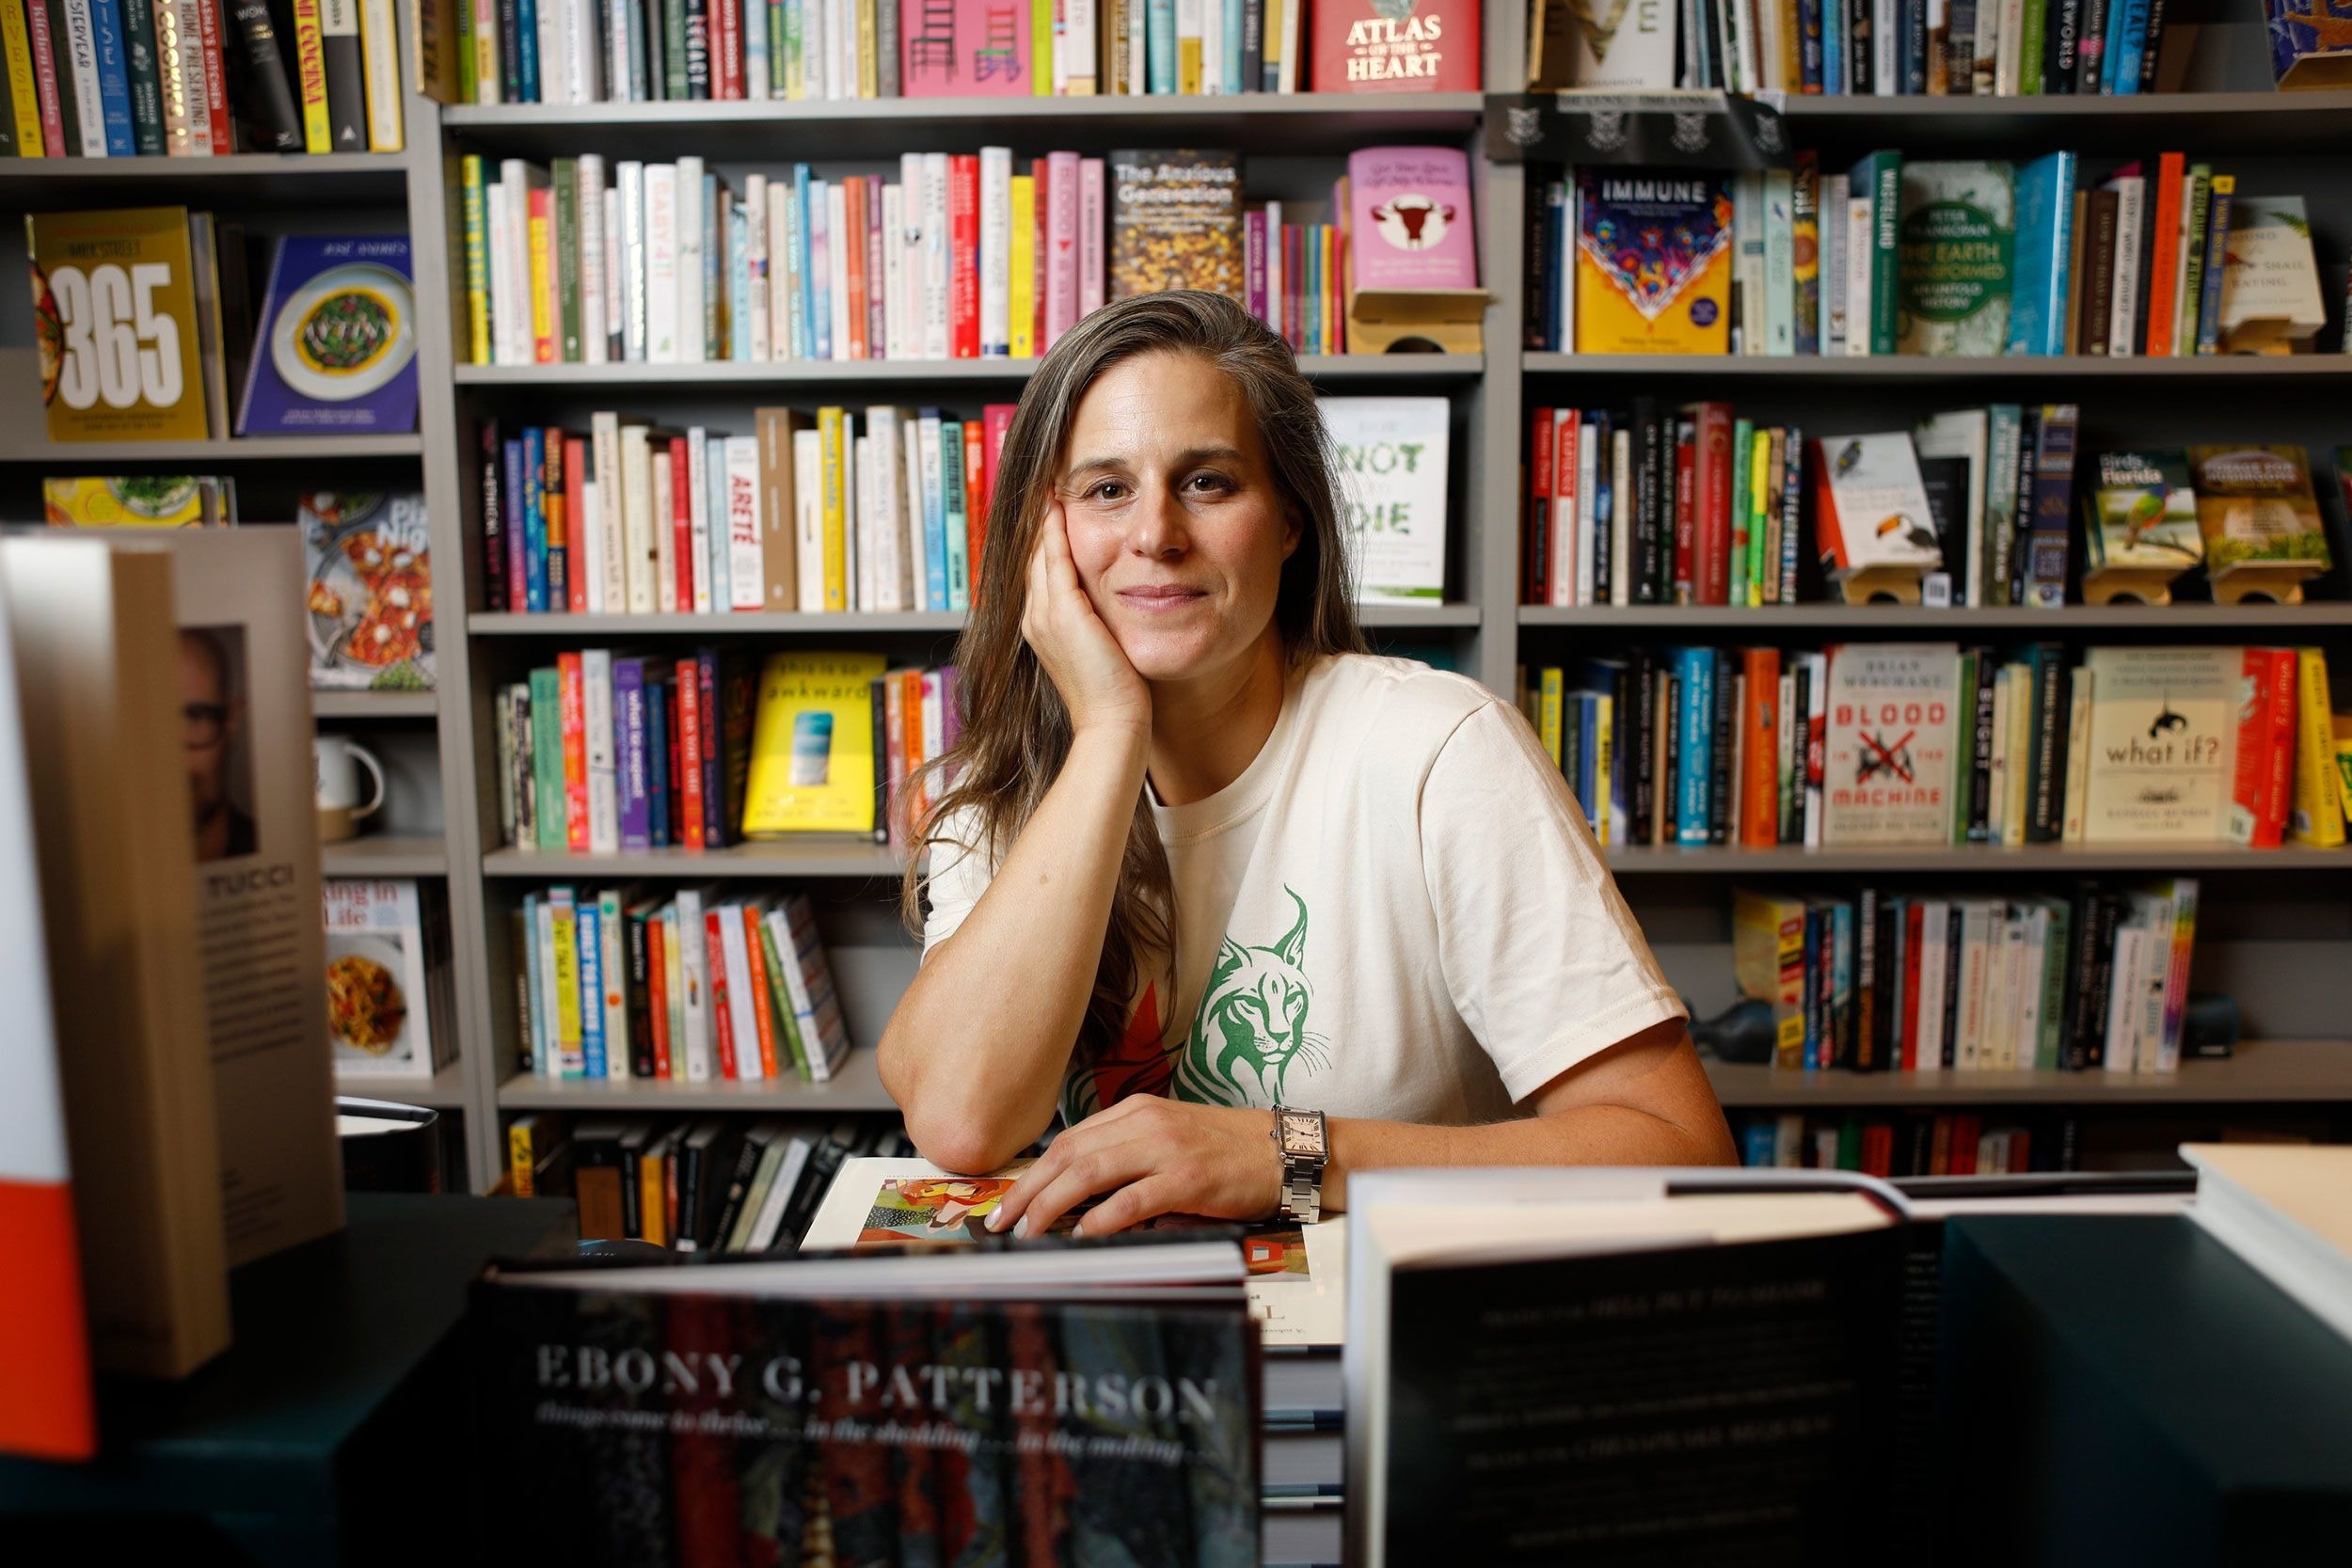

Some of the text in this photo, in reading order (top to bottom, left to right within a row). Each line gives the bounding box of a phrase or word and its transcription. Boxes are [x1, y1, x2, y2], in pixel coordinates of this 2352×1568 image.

[234, 5, 267, 22] WOK
[1346, 14, 1442, 46] ATLAS
[1346, 53, 1442, 82] HEART
[1115, 163, 1236, 182] The Anxious
[1117, 184, 1232, 204] Generation
[1602, 180, 1708, 203] IMMUNE
[1878, 167, 1899, 250] WASTELAND
[1935, 242, 2000, 261] EARTH
[1931, 281, 1984, 296] UNTOLD
[50, 263, 183, 408] 365
[1338, 442, 1424, 473] NOT
[2101, 467, 2163, 485] Florida
[779, 661, 863, 676] this is so
[766, 682, 869, 700] awkward
[1844, 676, 1943, 689] MERCHANT
[1836, 703, 1947, 727] BLOOD
[2106, 735, 2217, 765] what if?
[206, 864, 295, 897] TUCCI
[324, 880, 399, 907] ing in
[537, 1344, 1218, 1424] EBONY G. PATTERSON
[803, 1414, 830, 1441] in
[833, 1415, 871, 1443] the
[874, 1418, 980, 1453] shedding
[1017, 1426, 1041, 1451] in
[1046, 1428, 1086, 1457] the
[1089, 1435, 1184, 1465] molting
